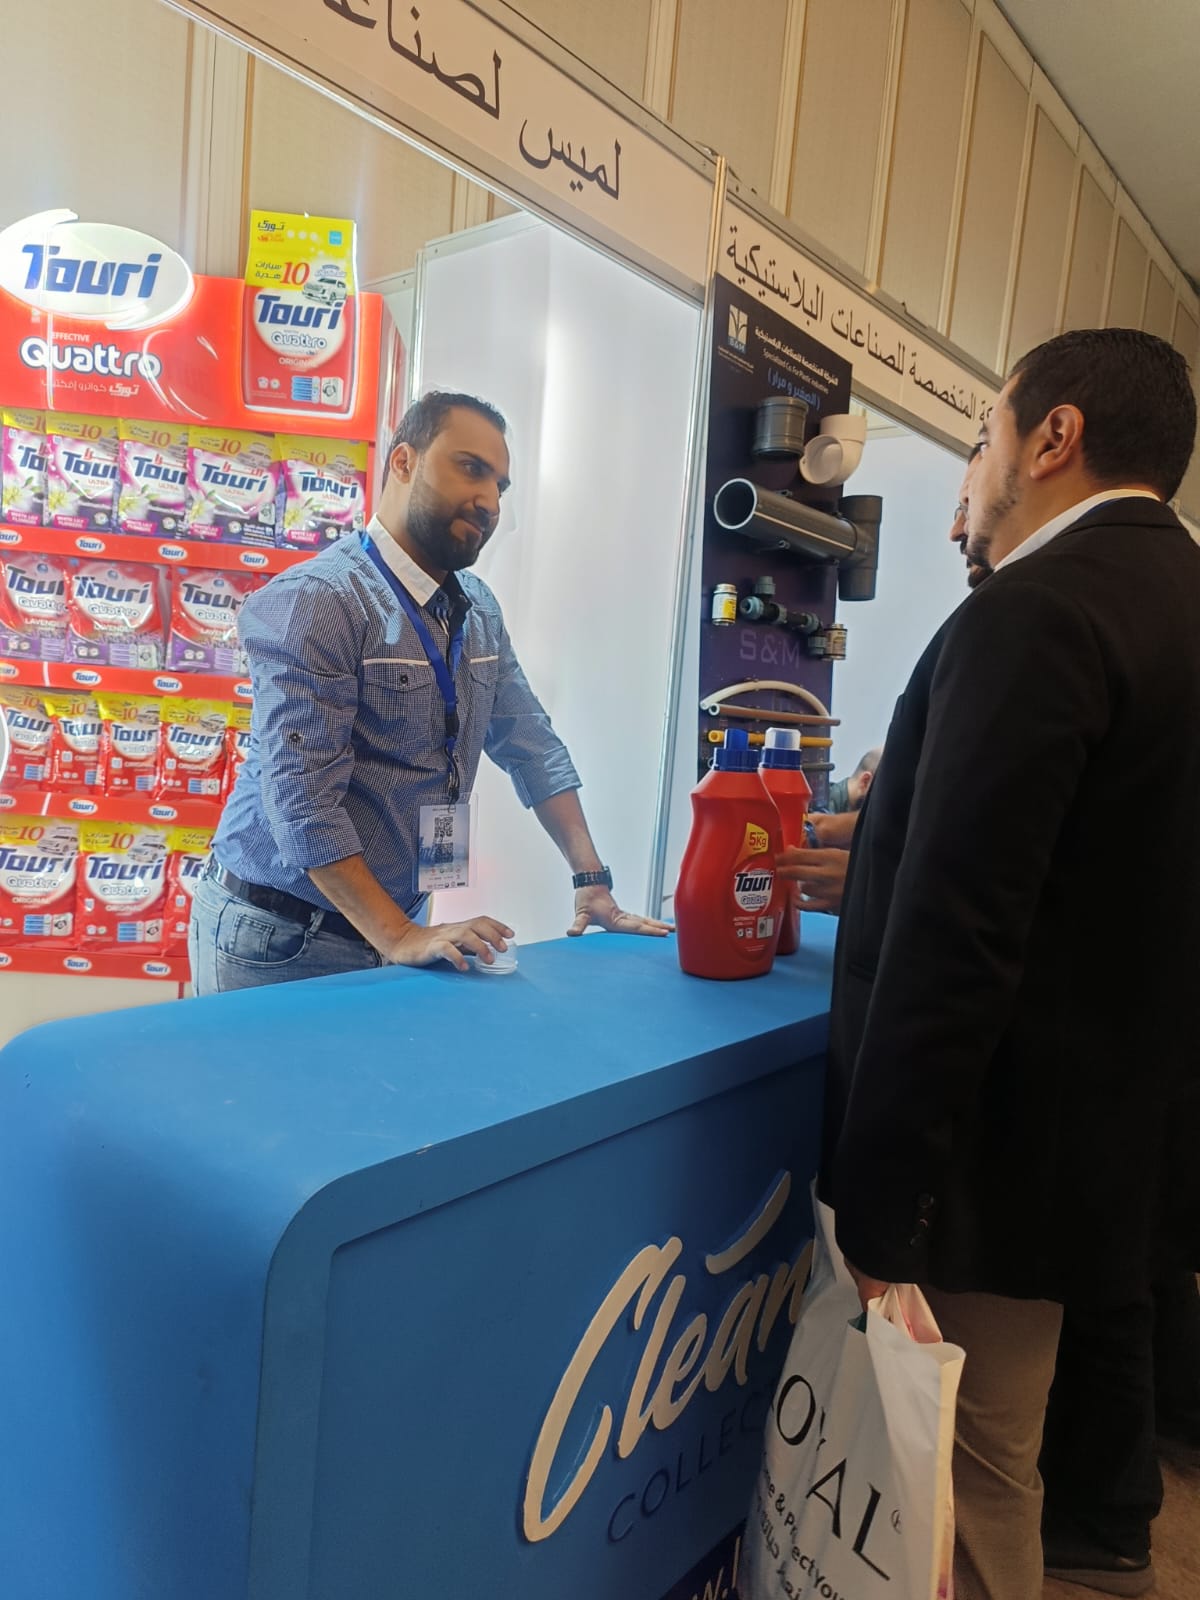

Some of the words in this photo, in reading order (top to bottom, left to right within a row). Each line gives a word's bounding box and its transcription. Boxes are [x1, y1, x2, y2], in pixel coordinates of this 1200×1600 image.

[322, 0, 502, 120] لصناع
[518, 119, 621, 201] لميس
[22, 244, 162, 299] Touri
[281, 261, 311, 287] 10
[726, 225, 824, 327] البلاستيكية
[257, 293, 345, 330] Touri
[271, 331, 328, 348] Quattro
[830, 309, 905, 376] للصناعات
[20, 336, 164, 381] Quattro
[908, 351, 976, 421] المتخصصة
[80, 424, 102, 440] 10
[151, 430, 171, 447] 10
[220, 438, 242, 455] 10
[62, 451, 118, 479] Tou
[310, 451, 327, 466] 10
[133, 456, 187, 485] Tou
[202, 463, 269, 493] Touri
[300, 471, 358, 499] Touri
[0, 532, 18, 542] ouri
[79, 539, 103, 550] Touri
[161, 547, 185, 557] Touri
[242, 554, 266, 565] Touri
[7, 565, 65, 596] Tou
[75, 672, 98, 682] Touri
[156, 679, 180, 689] Touri
[237, 686, 253, 695] Tou
[70, 703, 87, 716] 10
[122, 707, 138, 722] 10
[7, 709, 54, 732] Tour
[112, 724, 158, 742] Tour
[170, 727, 224, 746] Touri
[72, 801, 95, 811] Touri
[152, 807, 175, 817] Touri
[17, 826, 45, 841] 10
[111, 833, 135, 849] 10
[749, 831, 767, 848] 5Kg
[89, 857, 164, 880] Touri
[736, 872, 774, 893] Touri
[66, 960, 90, 971] Touri
[145, 965, 169, 976] Touri
[606, 1391, 768, 1543] COLLEC
